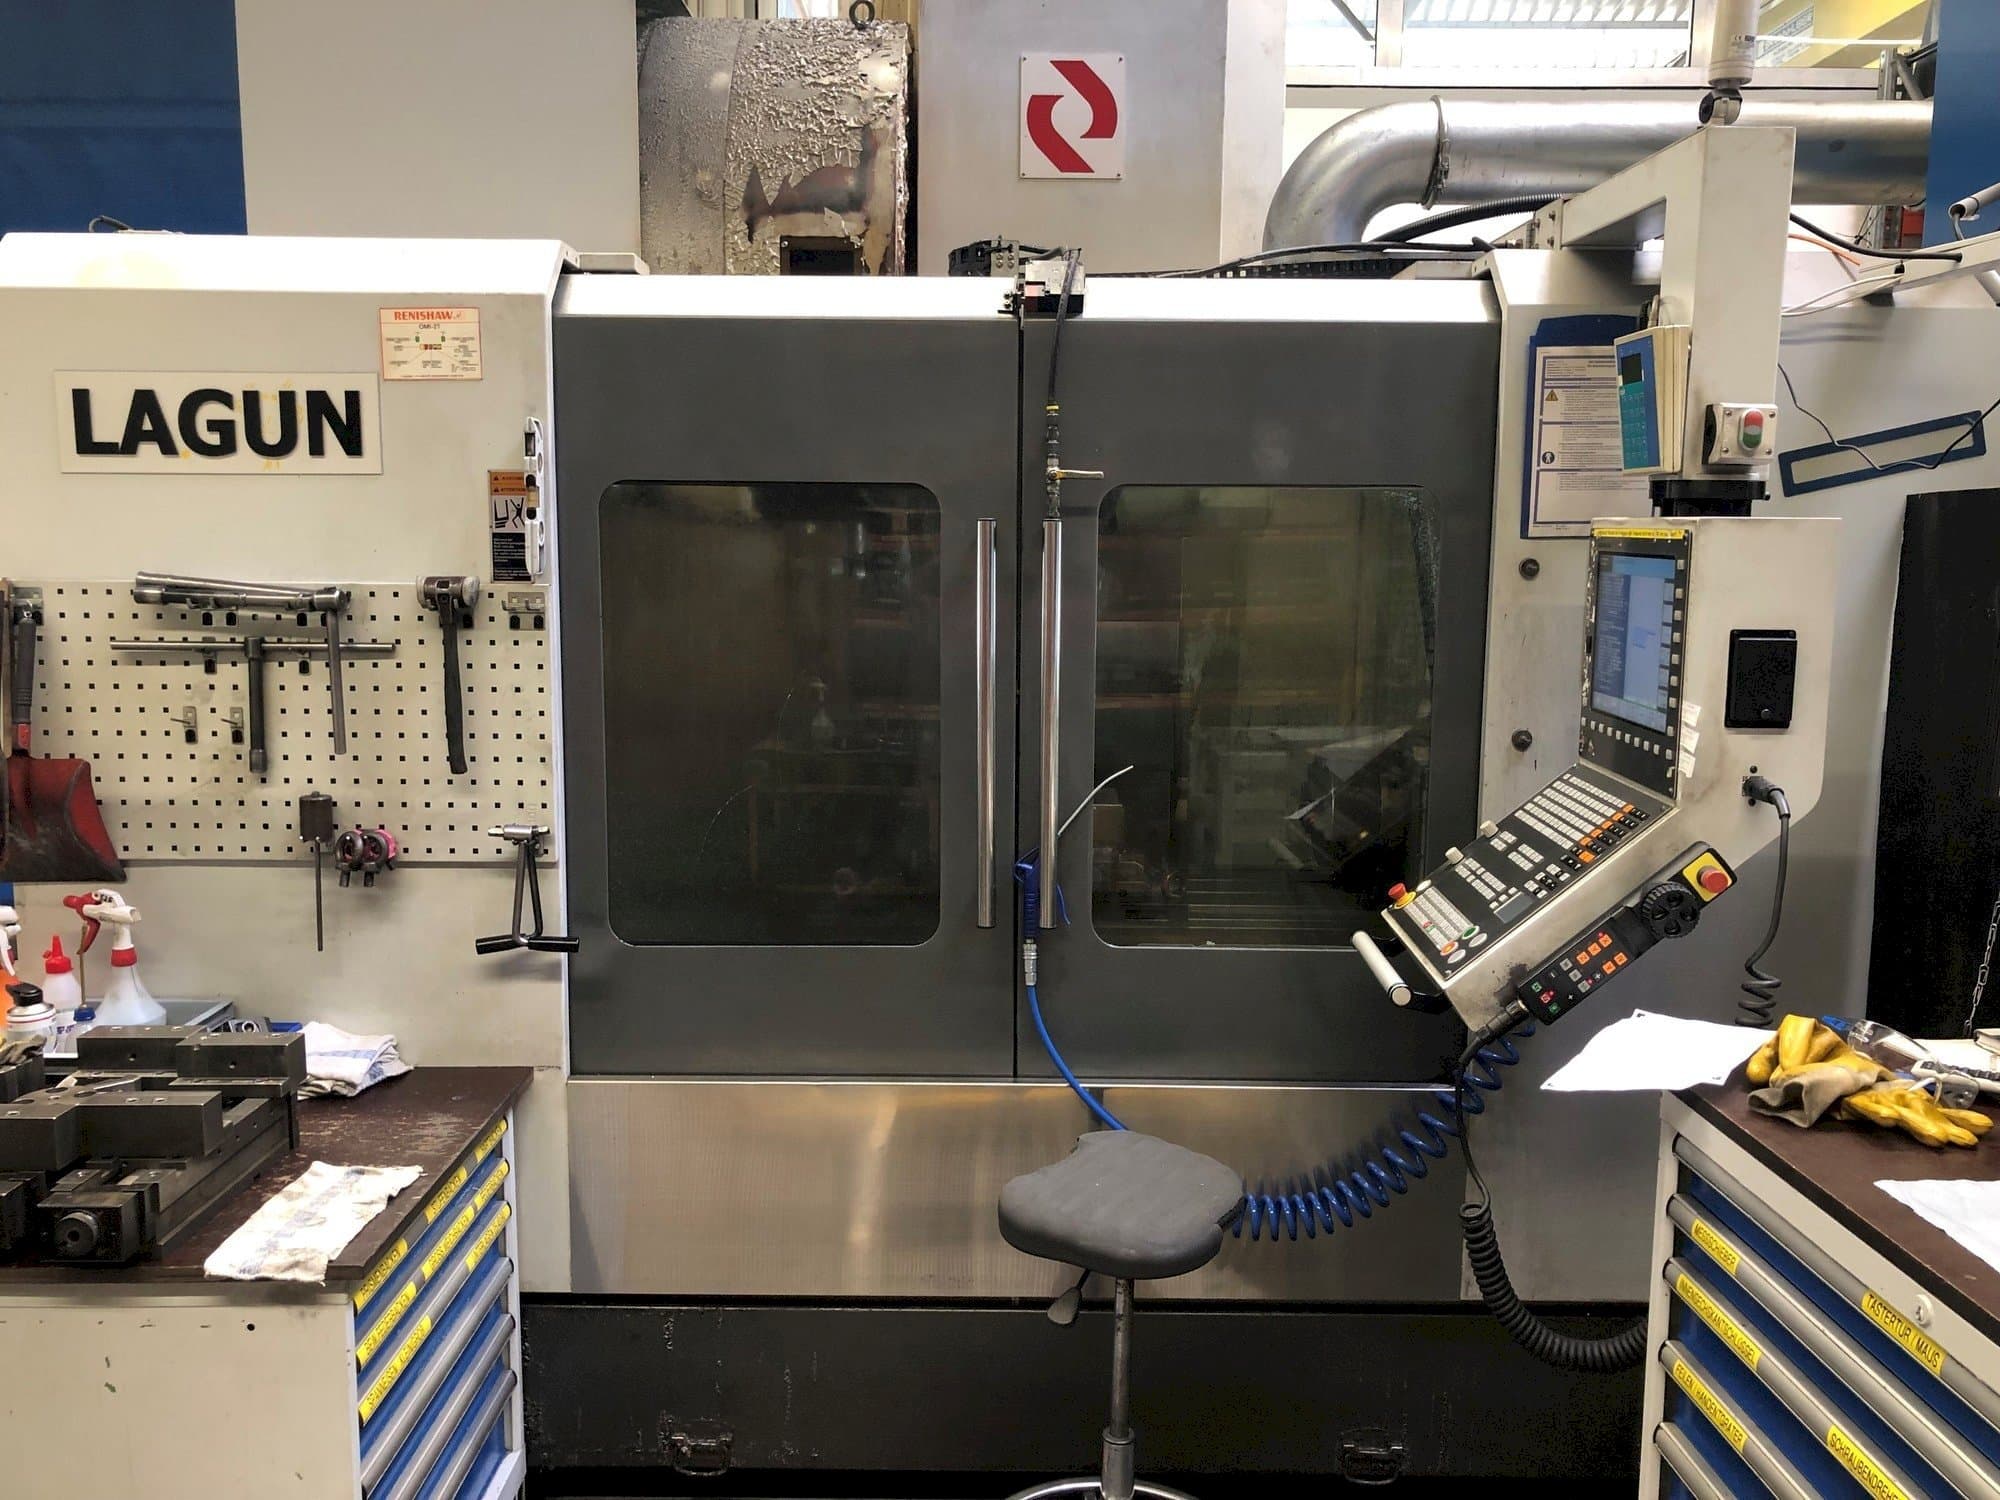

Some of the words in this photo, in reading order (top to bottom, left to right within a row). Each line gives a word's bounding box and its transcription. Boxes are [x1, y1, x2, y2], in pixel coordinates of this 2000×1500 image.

[394, 311, 453, 320] RENISHAW
[71, 388, 364, 458] LAGUN
[1867, 1293, 1912, 1342] TASTERTUR
[1915, 1337, 1941, 1368] MAUS
